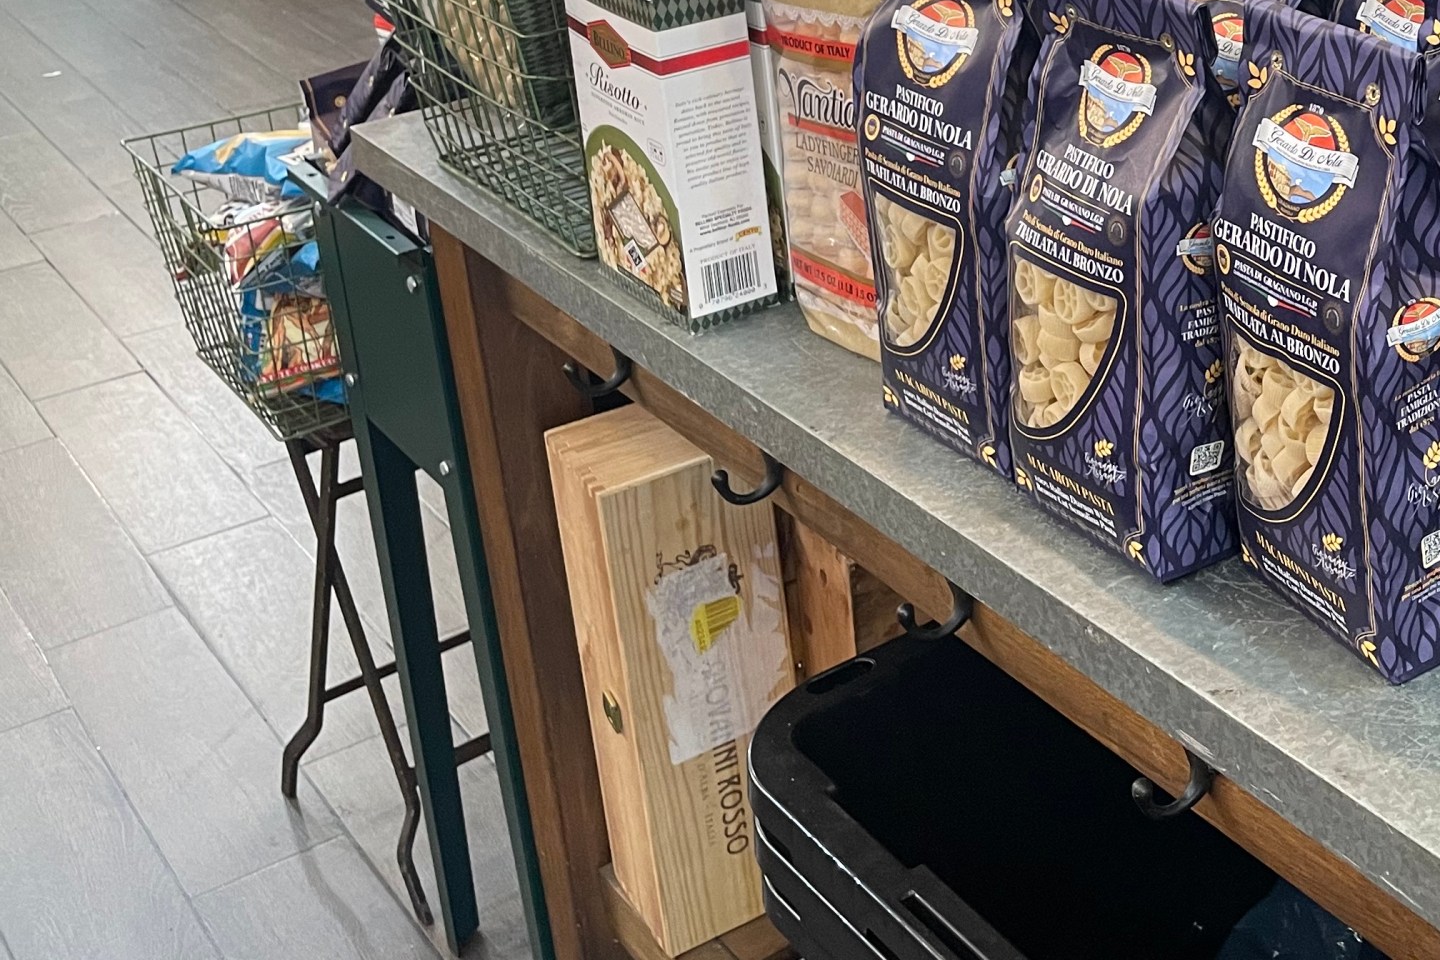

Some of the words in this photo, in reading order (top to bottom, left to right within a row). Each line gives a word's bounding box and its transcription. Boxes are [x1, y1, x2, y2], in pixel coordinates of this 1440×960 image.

[593, 30, 625, 58] BELLINO
[815, 43, 825, 54] OF
[826, 44, 851, 59] ITALY
[589, 62, 640, 110] Risotto
[896, 84, 943, 117] PASTIFICIO
[866, 91, 918, 131] GERARDO
[932, 119, 972, 150] NOLA
[1063, 143, 1114, 180] PASTIFICIO
[1268, 127, 1299, 157] Gerardo
[807, 157, 859, 189] SAVOIARDI
[865, 157, 908, 193] TRAFILATA
[919, 183, 961, 213] BRONZO
[1036, 149, 1084, 191] GERARDO
[1097, 183, 1133, 217] NOLA
[700, 252, 728, 264] PRODUCT
[739, 244, 756, 254] ITALY
[1015, 221, 1059, 259] TRAFILATA
[1072, 250, 1125, 285] BRONZO
[1250, 213, 1317, 259] PASTIFICIO
[1214, 217, 1283, 271] GERARDO
[1302, 262, 1351, 303] NOLA
[1222, 292, 1270, 341] TRAFILATA
[1286, 337, 1341, 375] BRONZO
[1400, 391, 1438, 417] FAMIGLIA
[1077, 480, 1115, 517] PASTA
[1306, 573, 1347, 613] PASTA
[718, 774, 749, 855] ROSSO
